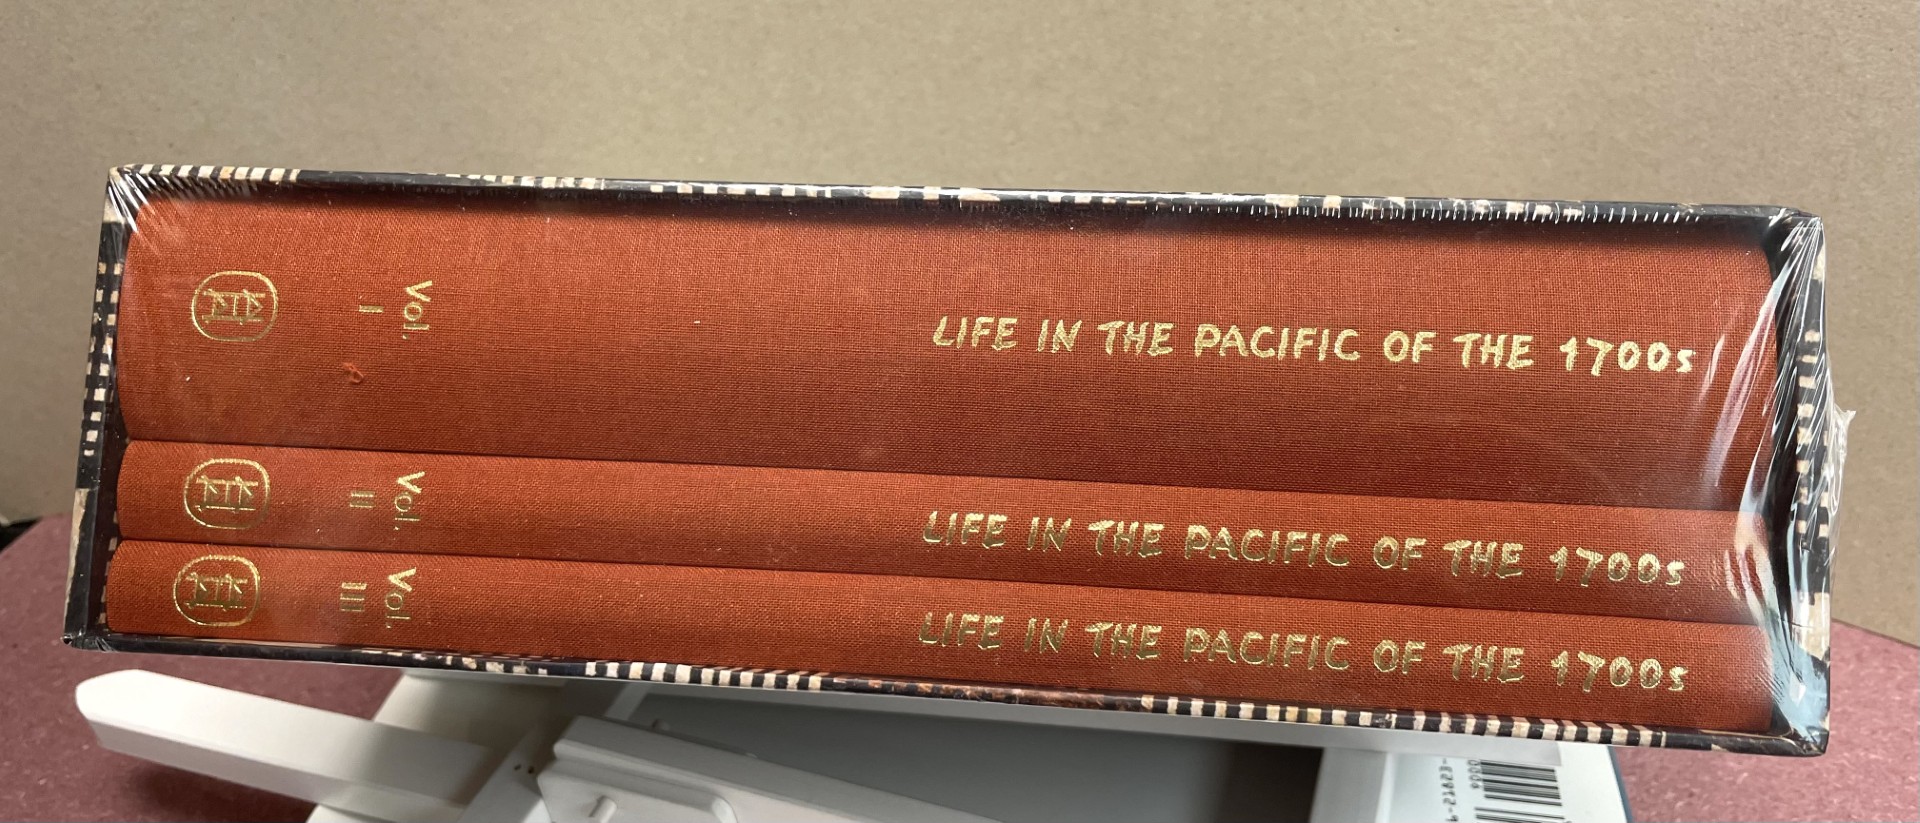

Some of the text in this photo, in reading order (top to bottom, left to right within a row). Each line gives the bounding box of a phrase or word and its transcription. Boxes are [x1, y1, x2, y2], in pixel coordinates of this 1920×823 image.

[402, 280, 433, 341] Vol.
[932, 315, 1697, 377] LIFE IN THE PACIFIC OF THE 1700s
[349, 491, 375, 508] II
[393, 471, 426, 533] Vol.
[922, 510, 1685, 587] LIFE IN THE PACIFIC OF THE 1700s
[339, 581, 367, 612] III
[384, 566, 417, 630] Vol.
[918, 611, 1688, 693] LIFE IN THE PACIFIC OF THE 1700s
